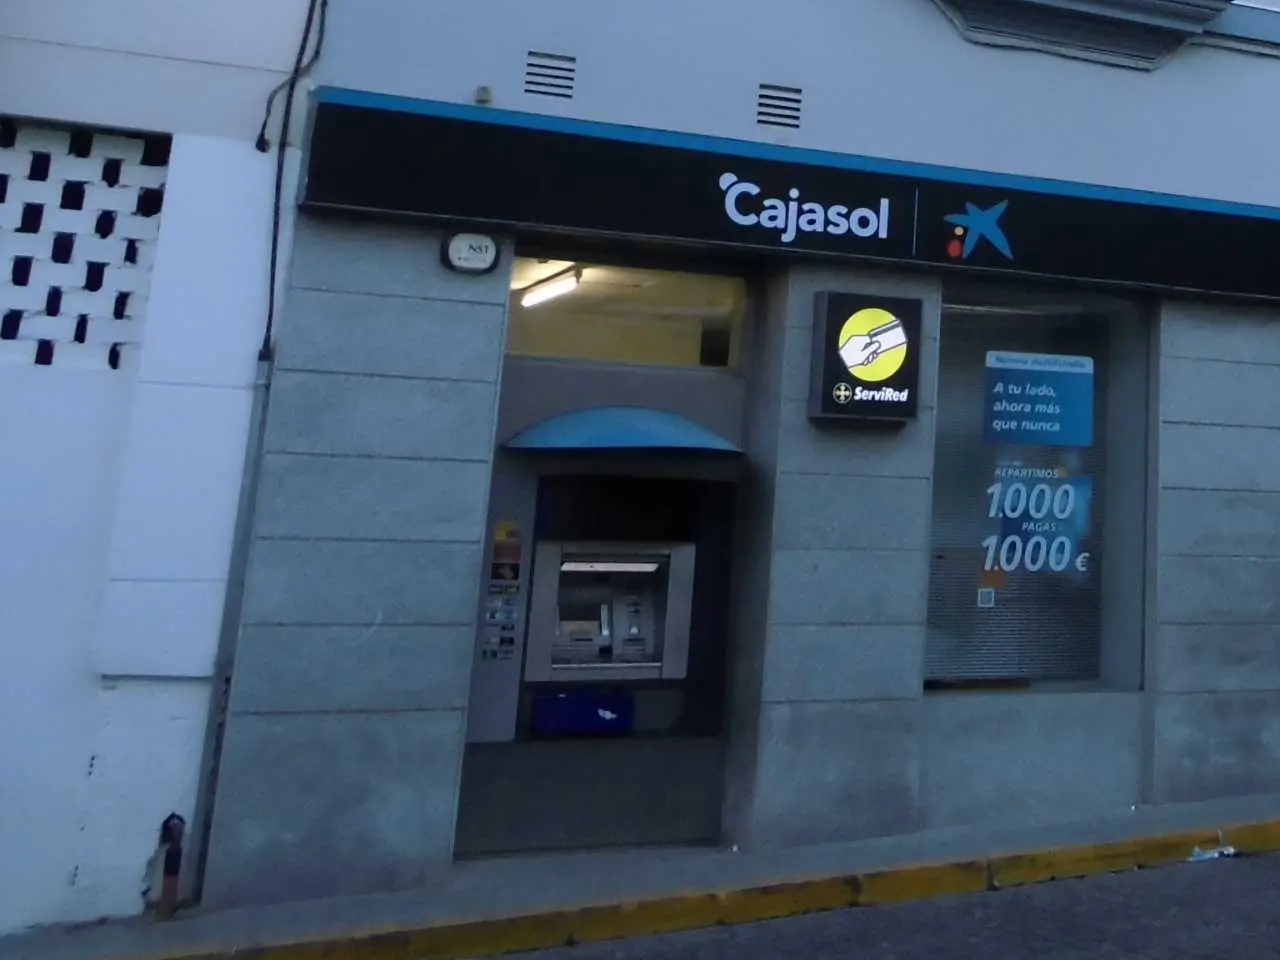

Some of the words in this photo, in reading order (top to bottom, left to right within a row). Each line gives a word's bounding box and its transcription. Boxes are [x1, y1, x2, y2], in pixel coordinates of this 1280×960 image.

[719, 172, 890, 243] Cajasol
[853, 386, 909, 403] ServiRed
[993, 382, 1004, 394] A
[1008, 384, 1022, 395] tu
[1025, 383, 1057, 398] lado,
[993, 400, 1032, 413] ahora
[1034, 401, 1061, 415] más
[992, 419, 1018, 432] que
[1021, 421, 1061, 432] nunca
[995, 467, 1060, 479] REPARTIMOS
[1021, 521, 1057, 532] PAGAS
